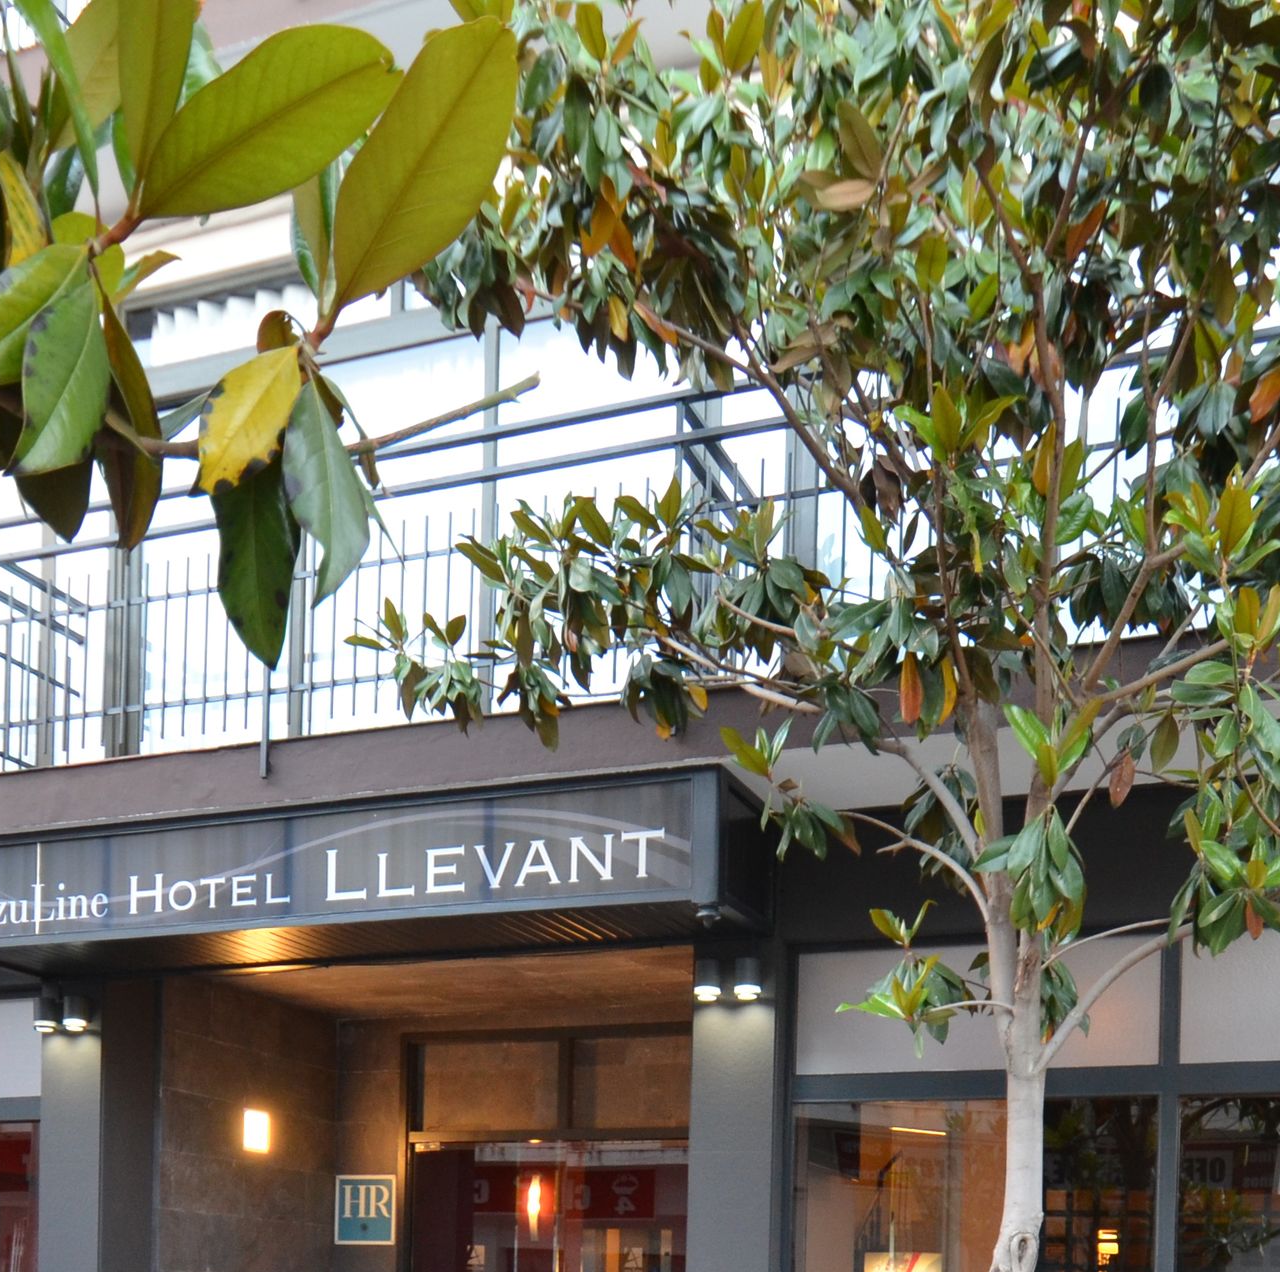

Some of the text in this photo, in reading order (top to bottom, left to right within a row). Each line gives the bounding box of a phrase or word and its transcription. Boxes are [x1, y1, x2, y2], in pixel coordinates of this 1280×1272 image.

[129, 872, 291, 915] HOTEL
[325, 827, 665, 901] LLEVANT
[342, 1184, 391, 1218] HR
